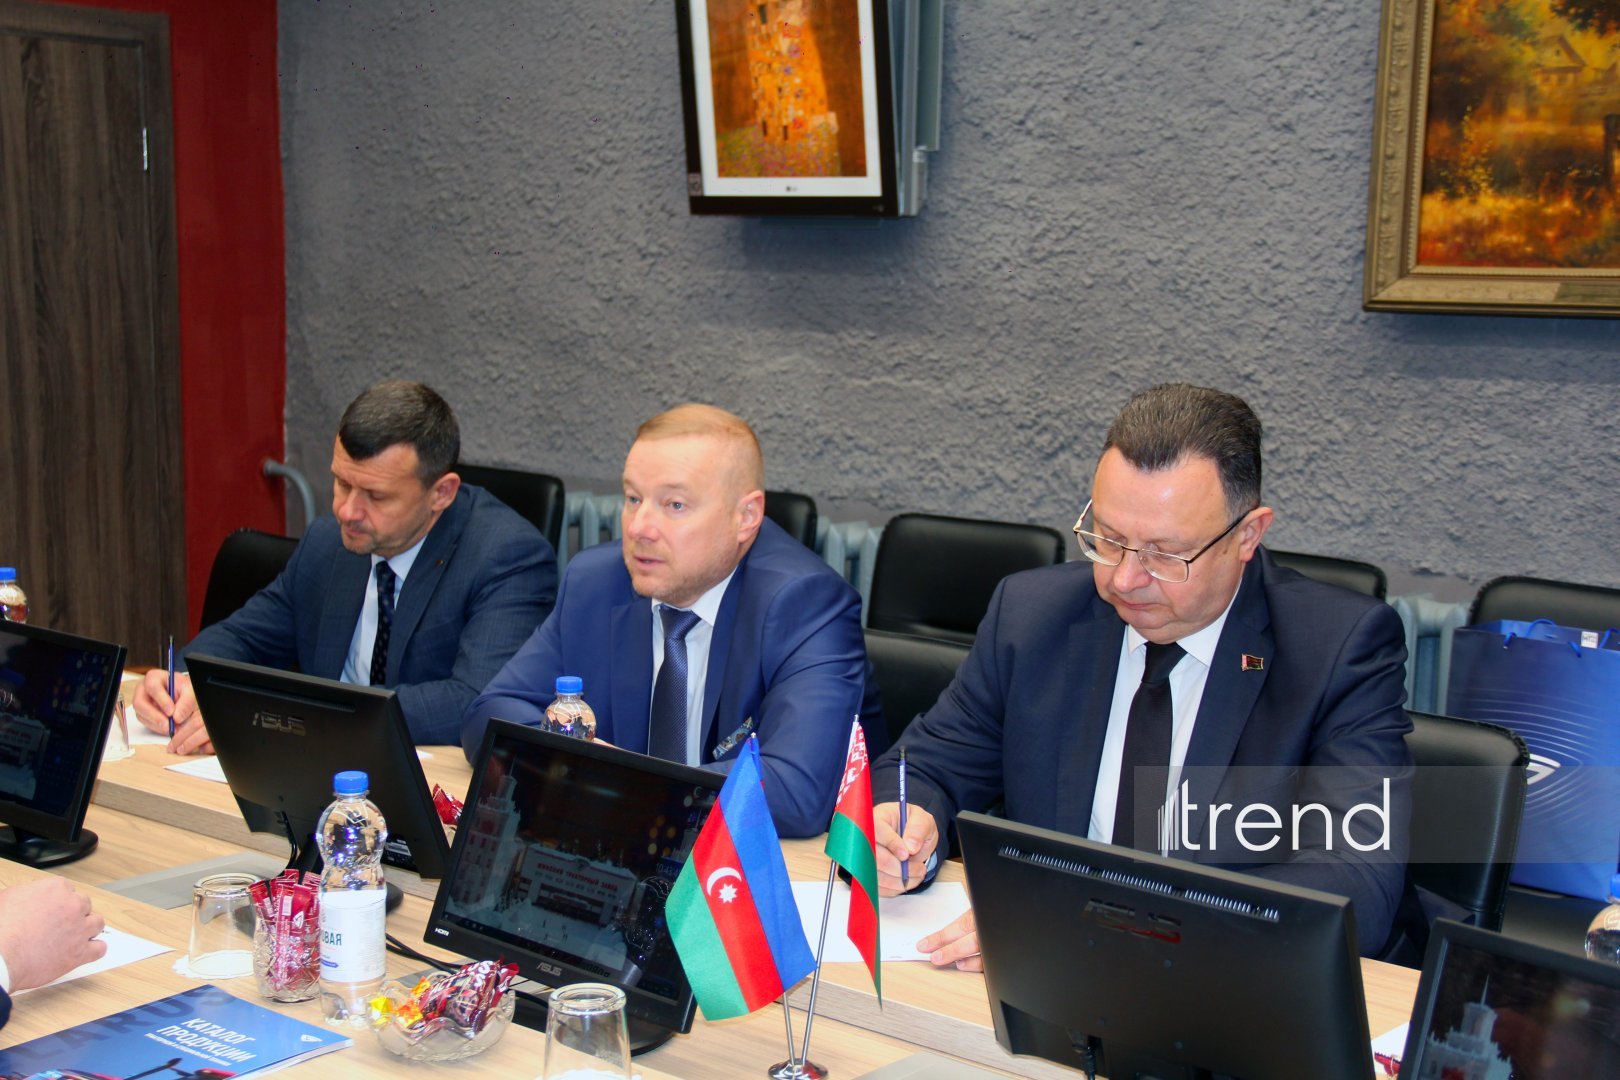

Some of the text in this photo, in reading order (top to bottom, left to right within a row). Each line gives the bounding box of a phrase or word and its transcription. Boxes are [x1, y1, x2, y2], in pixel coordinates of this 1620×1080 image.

[536, 962, 563, 977] ASUS
[156, 1025, 258, 1063] ПРОДУКЦИИ
[181, 1017, 257, 1045] КАТАЛОГ
